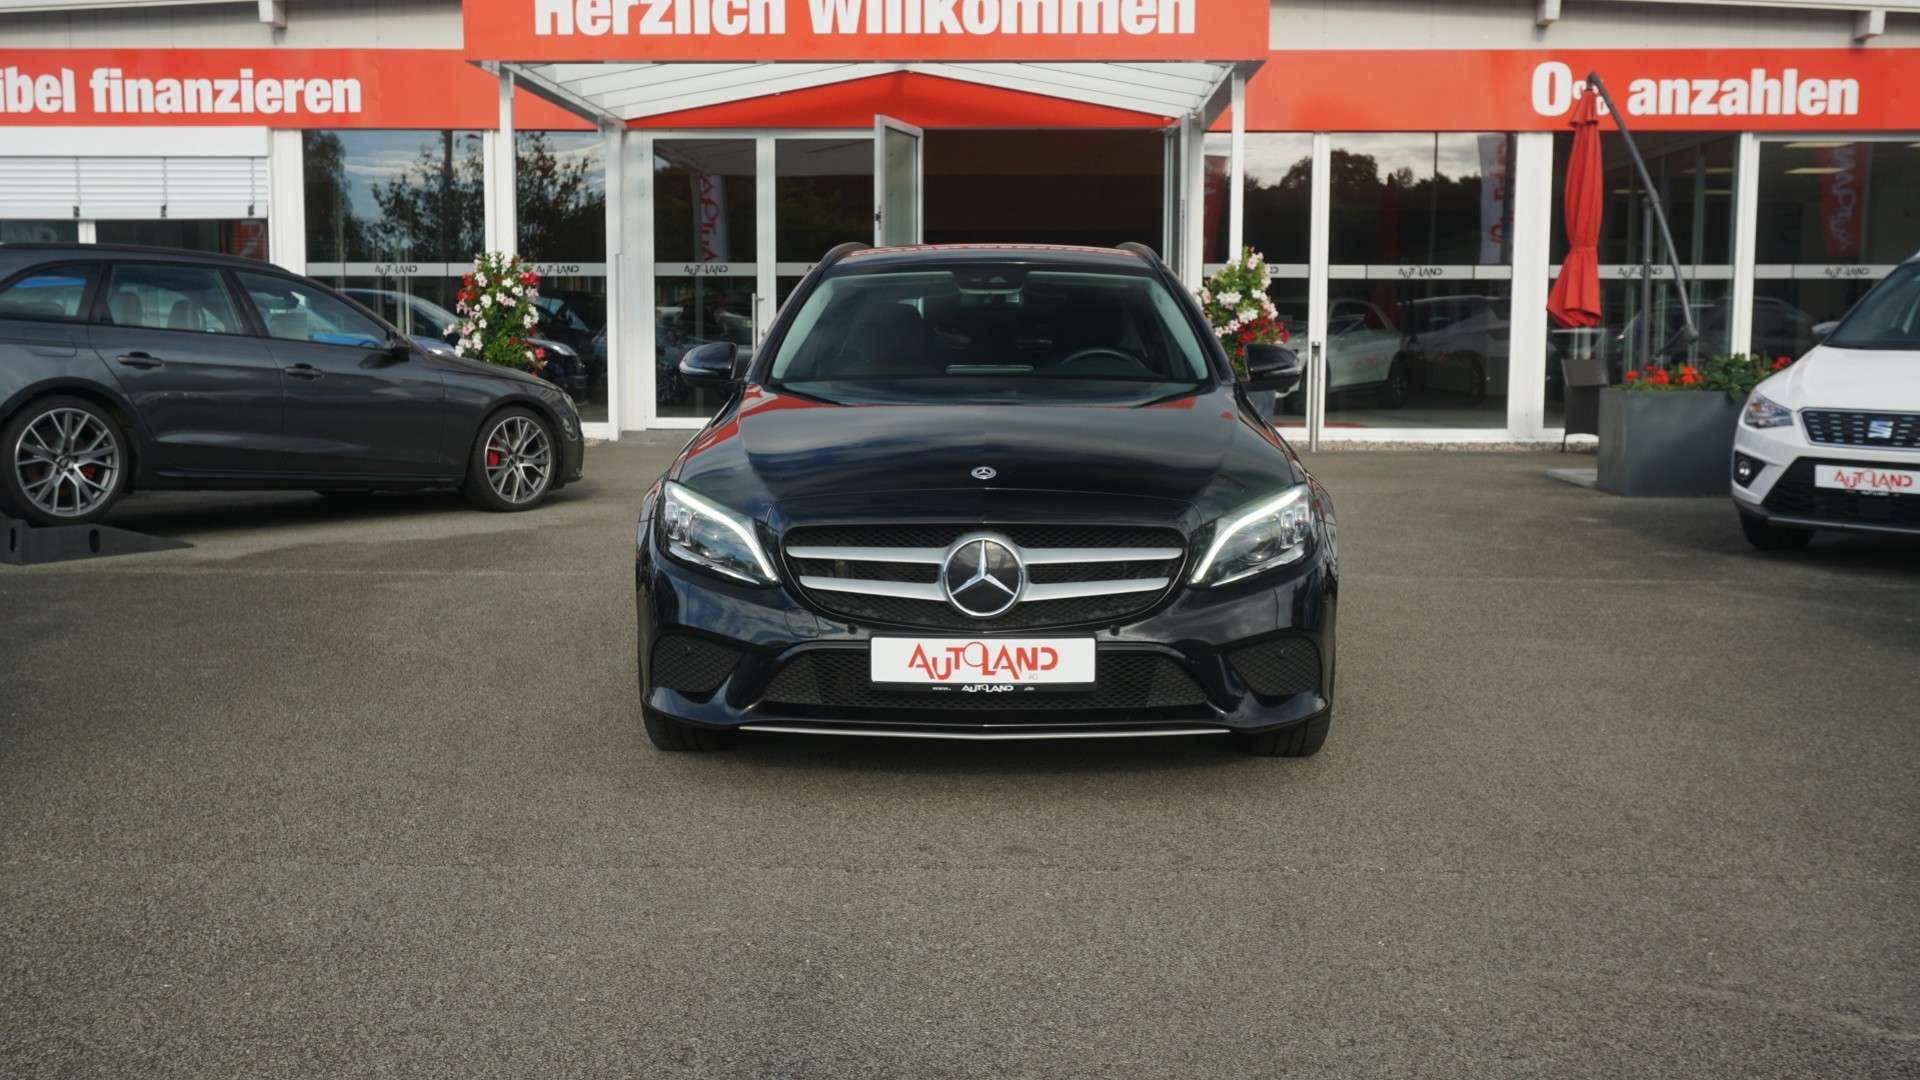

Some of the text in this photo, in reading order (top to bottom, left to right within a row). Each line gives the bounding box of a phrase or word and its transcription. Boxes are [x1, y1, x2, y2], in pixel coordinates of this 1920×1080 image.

[535, 0, 1196, 36] Herzlich Willkommen
[90, 68, 362, 113] finanzieren
[1627, 68, 1859, 116] anzahlen
[1834, 469, 1914, 490] AUTOLAND
[908, 641, 1059, 680] AUTOLAND
[961, 684, 1014, 692] AUTOLAND
